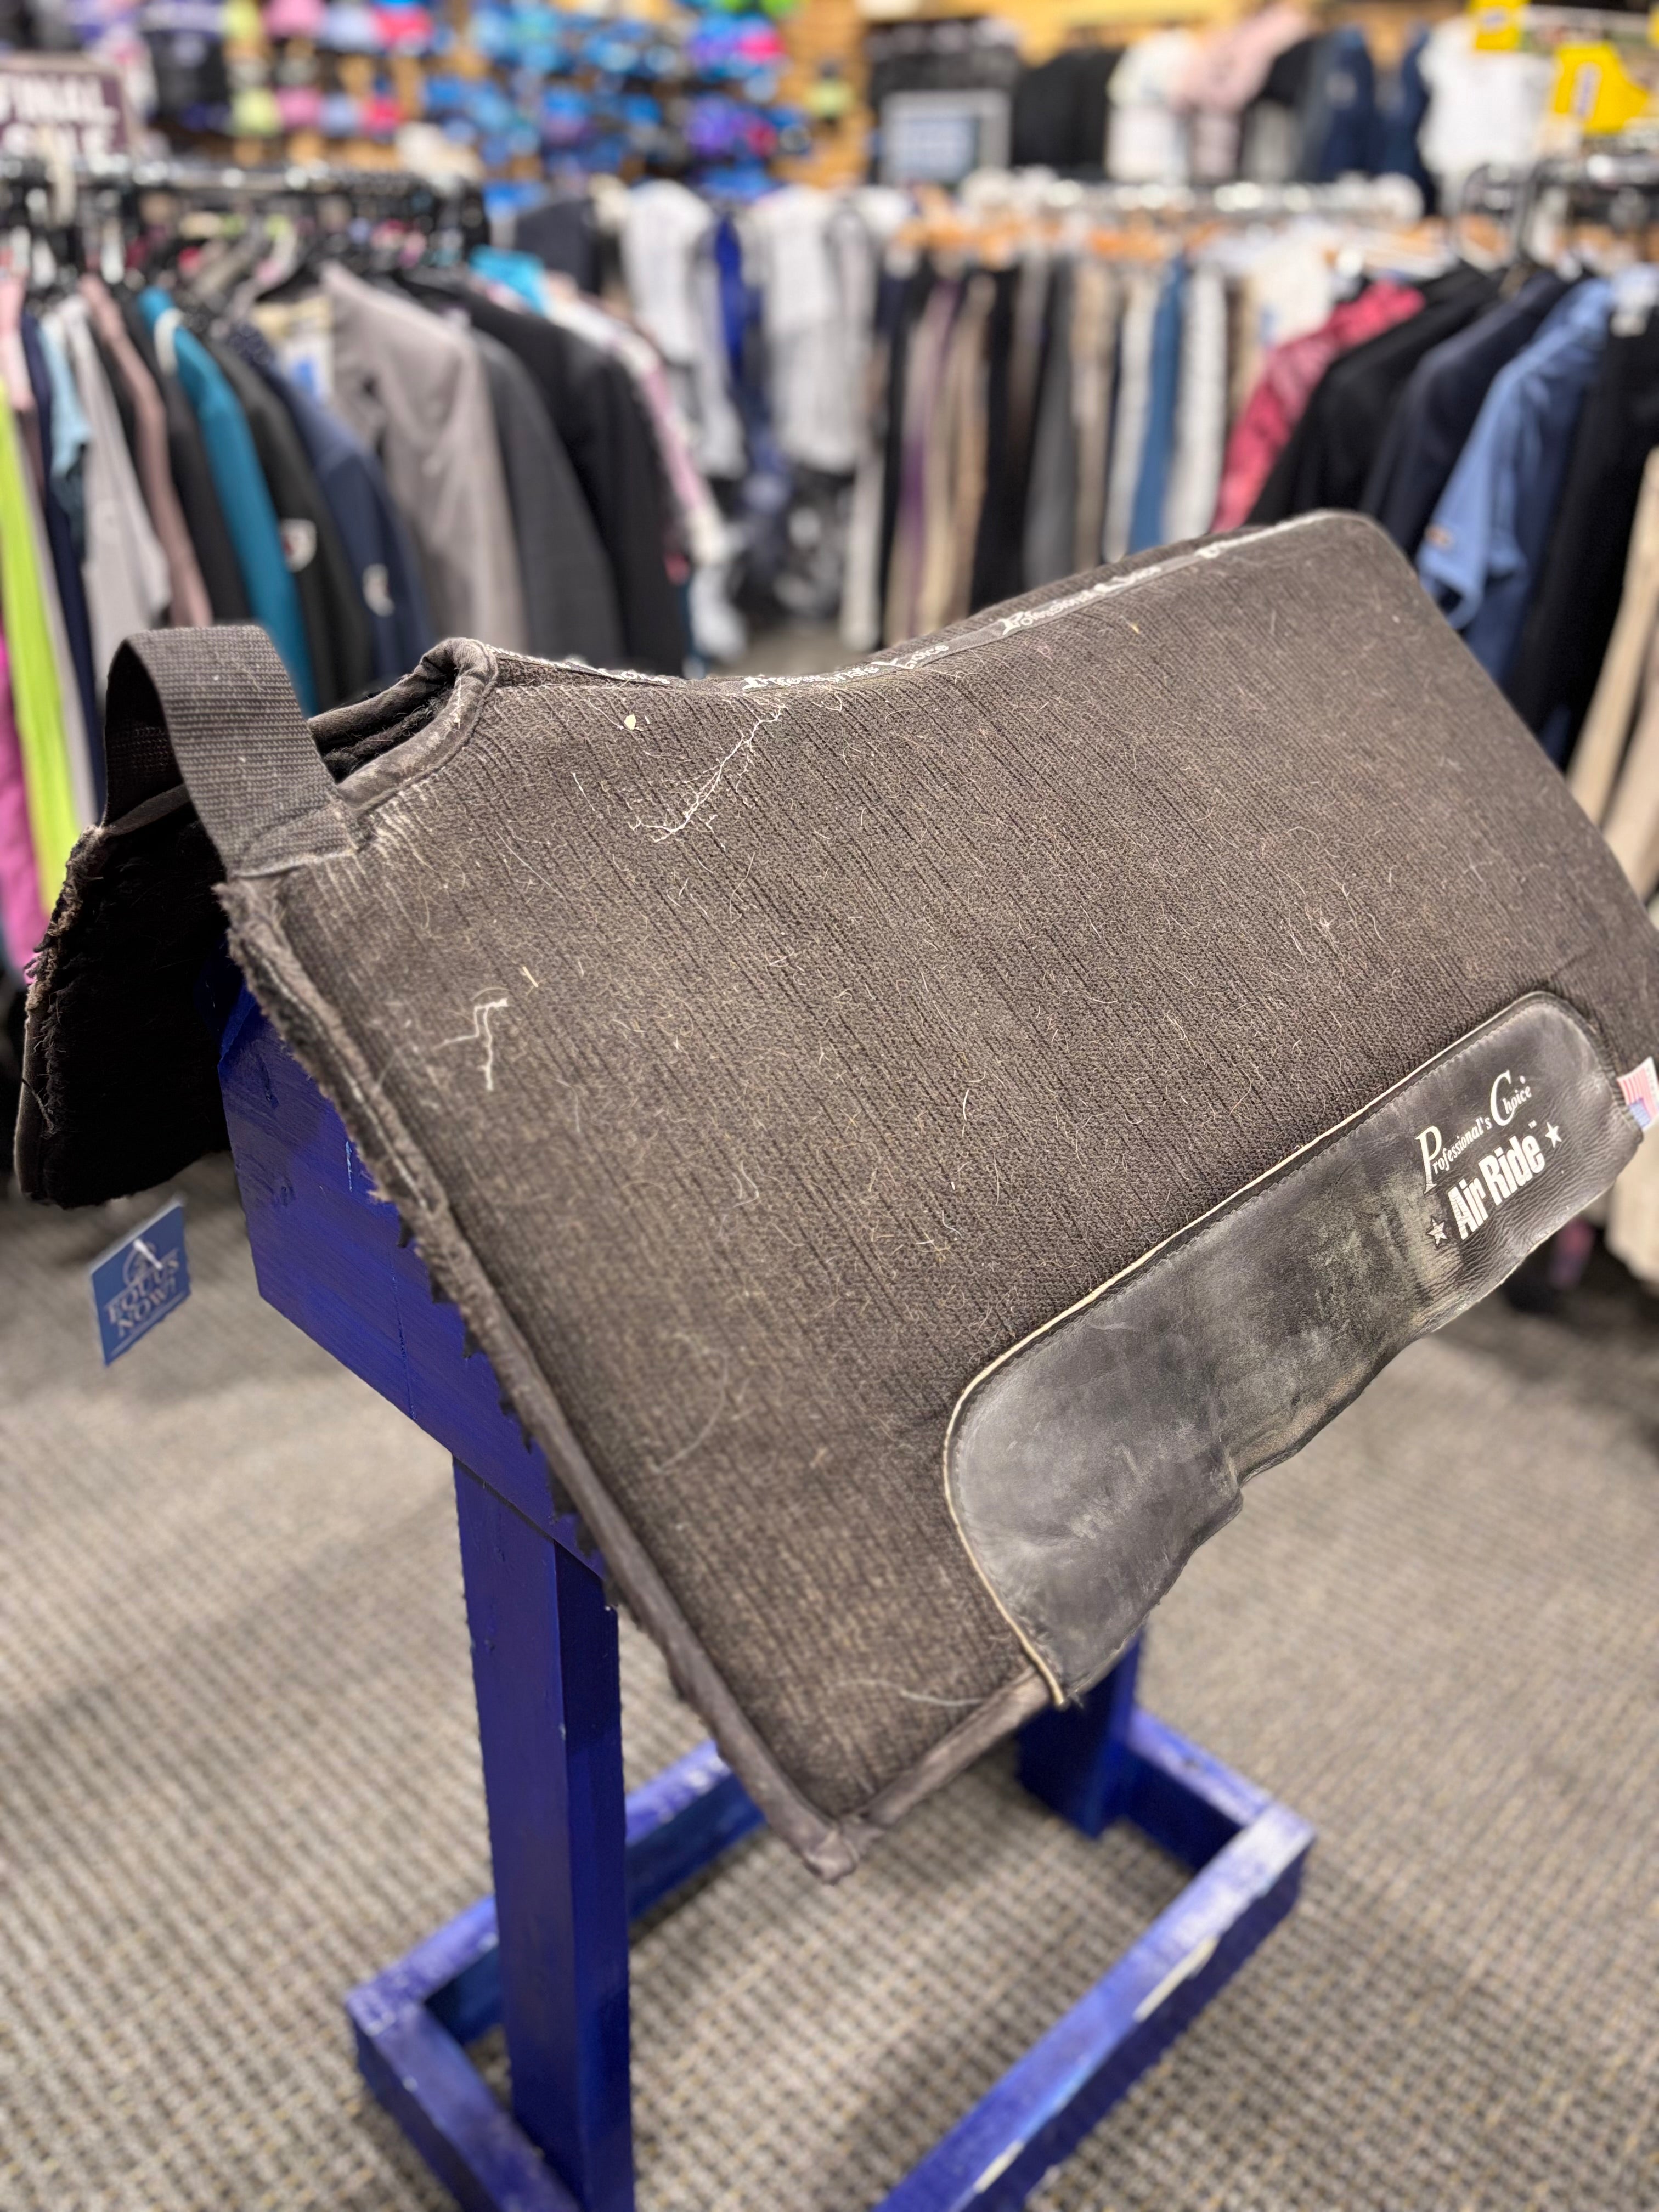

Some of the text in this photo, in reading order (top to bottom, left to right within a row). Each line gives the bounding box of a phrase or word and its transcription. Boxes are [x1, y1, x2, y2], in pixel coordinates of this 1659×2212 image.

[1415, 1069, 1532, 1194] Professional's Choice
[1447, 1178, 1488, 1240] Air
[1478, 1135, 1545, 1206] Ride
